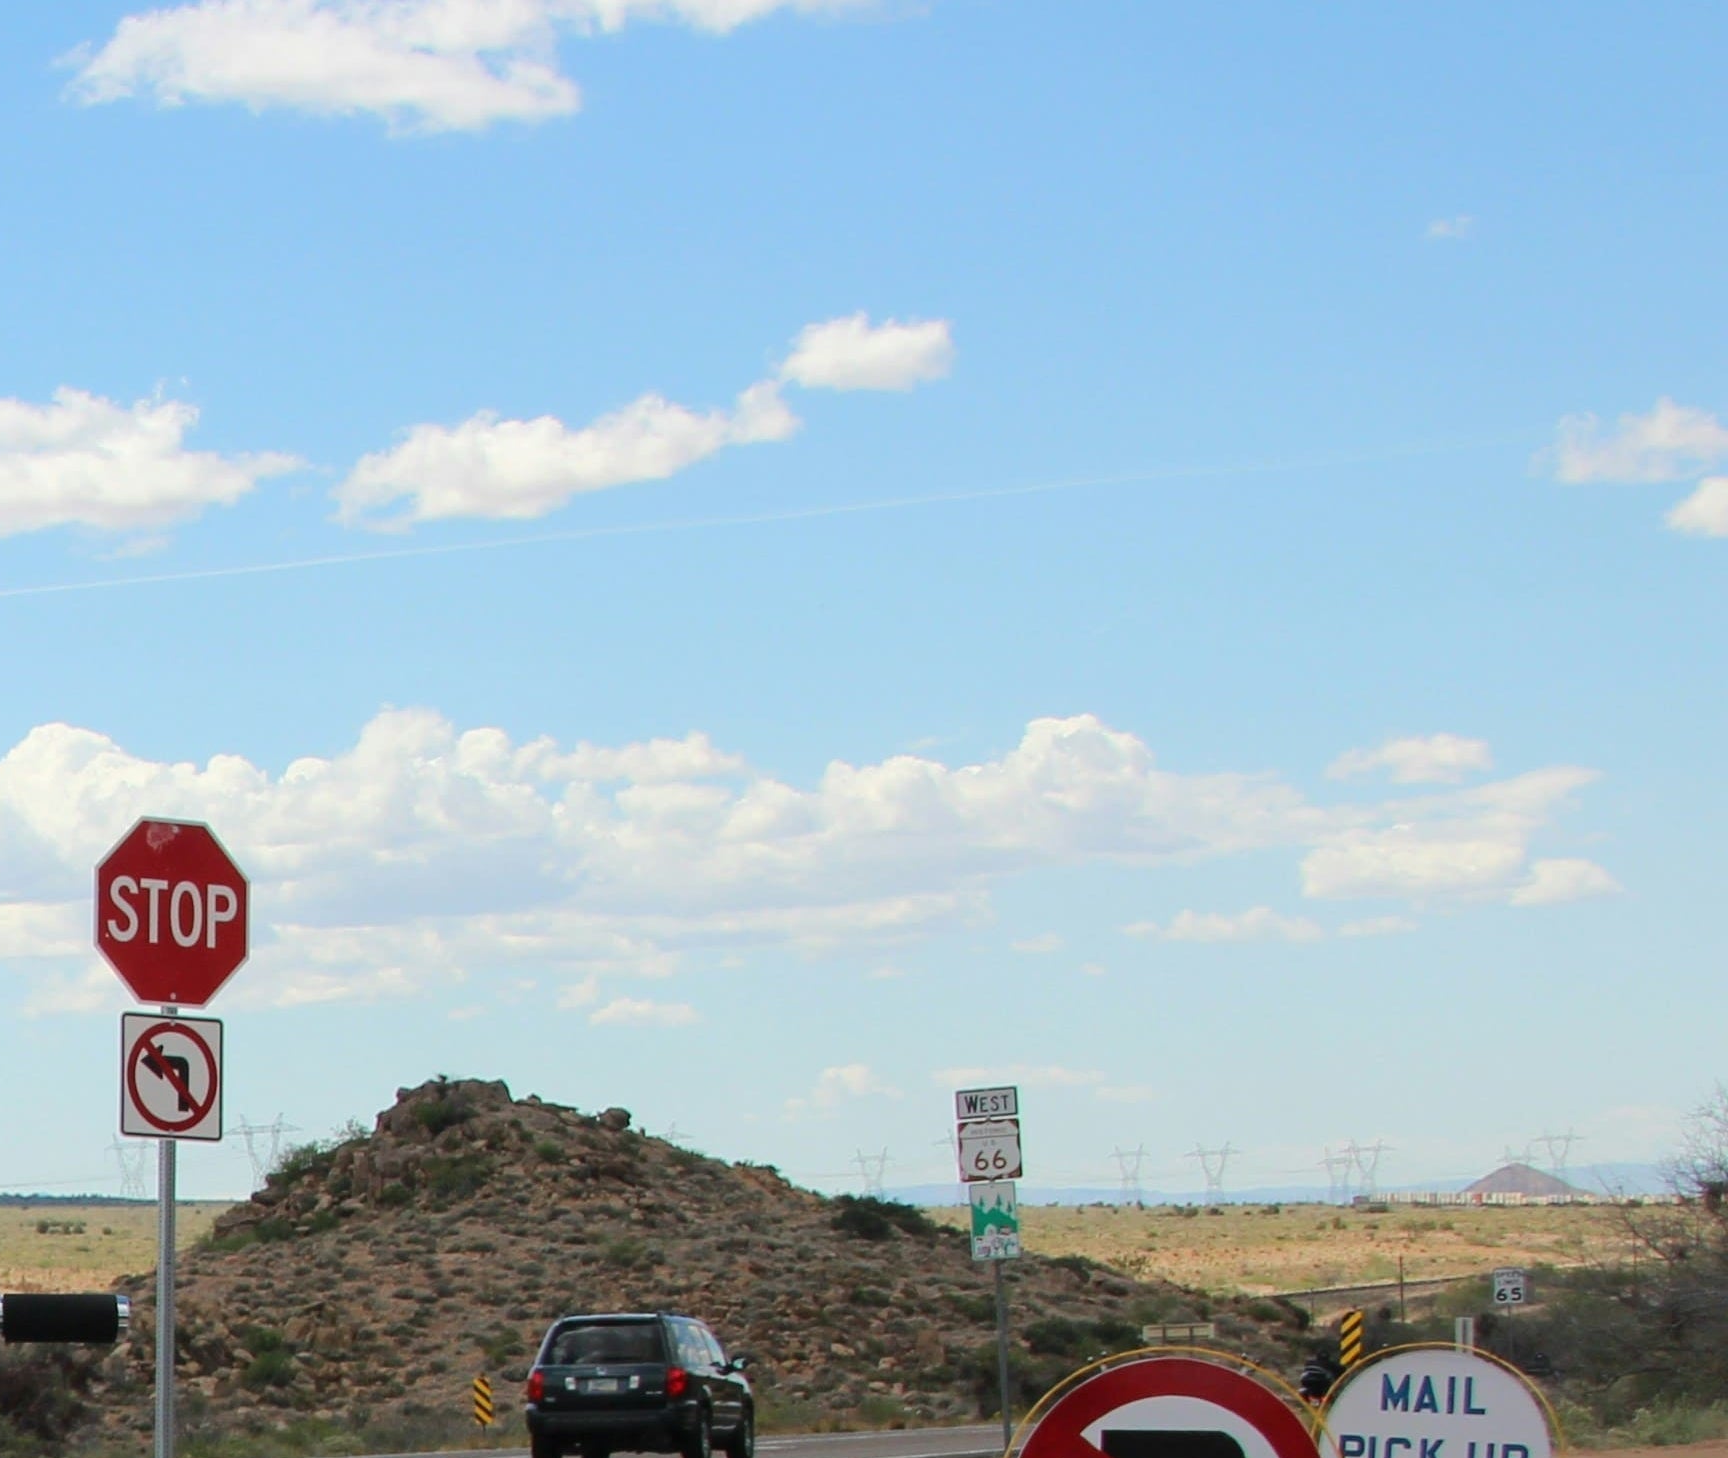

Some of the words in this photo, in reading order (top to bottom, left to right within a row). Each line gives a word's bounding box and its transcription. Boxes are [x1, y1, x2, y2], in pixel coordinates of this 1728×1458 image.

[107, 875, 238, 949] STOP
[964, 1094, 1009, 1114] WEST
[974, 1149, 1007, 1171] 66
[1496, 1287, 1522, 1302] 65
[1380, 1373, 1486, 1416] MAIL
